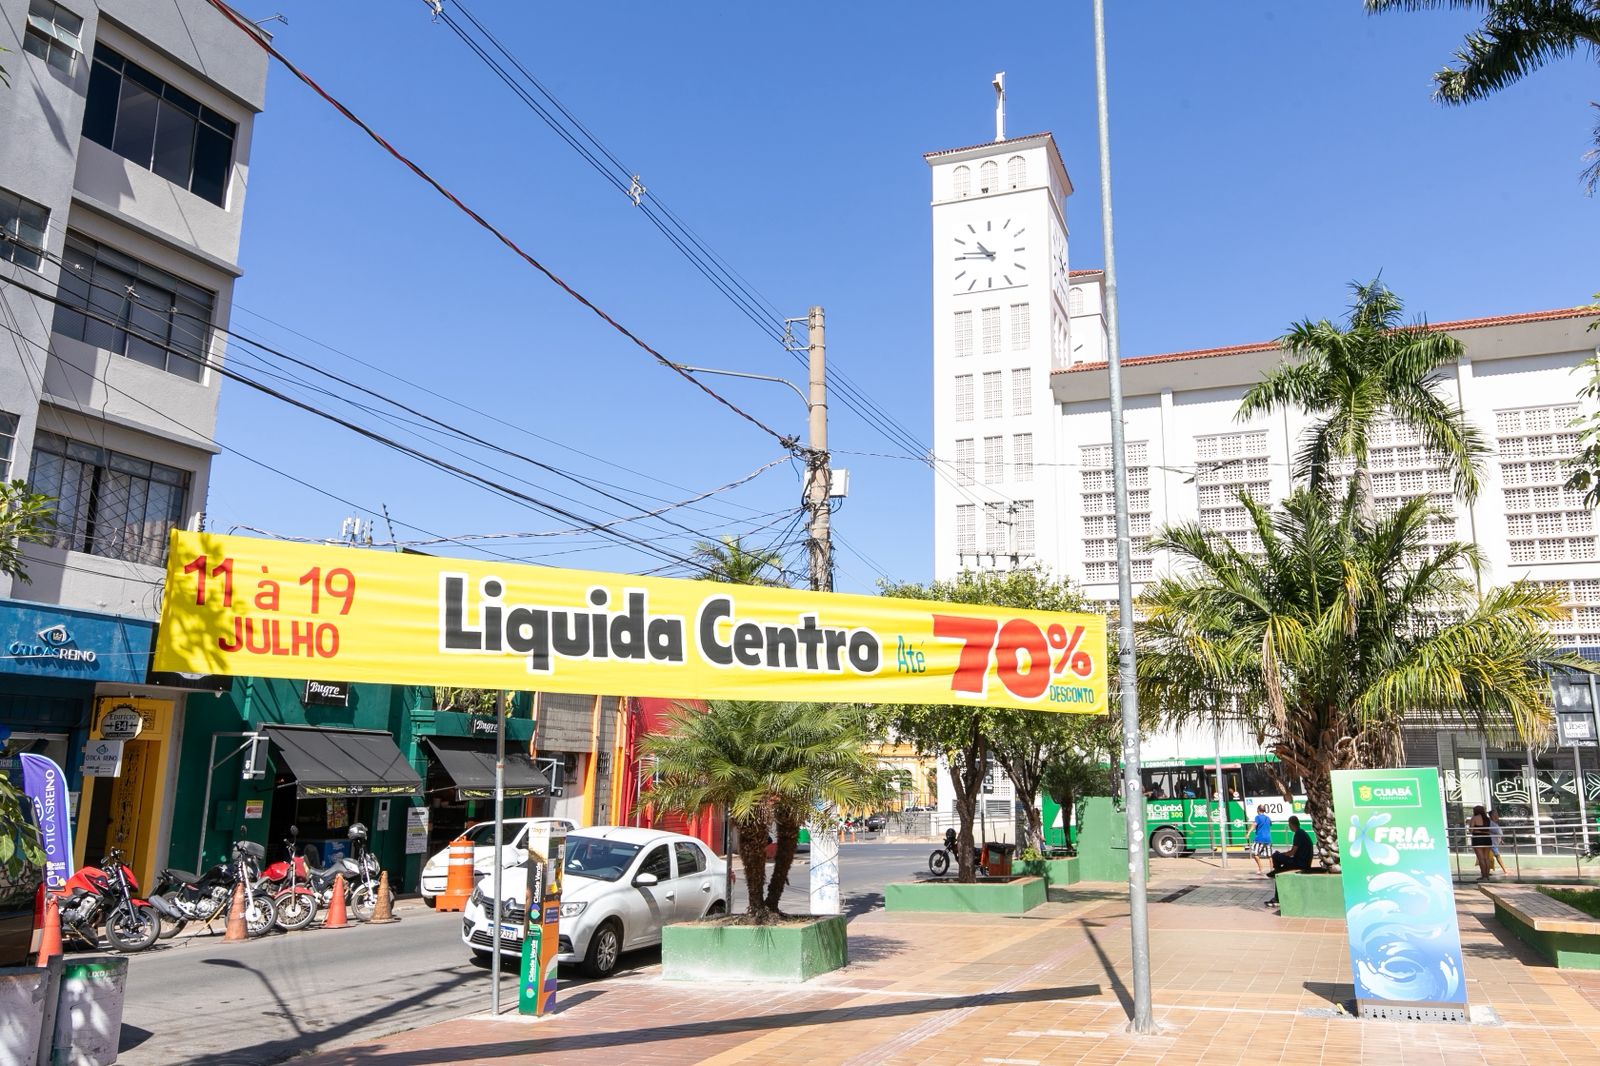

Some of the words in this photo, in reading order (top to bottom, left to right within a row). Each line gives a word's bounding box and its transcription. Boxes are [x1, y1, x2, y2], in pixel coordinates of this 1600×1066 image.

[184, 555, 234, 608] 11
[254, 565, 281, 612] à
[299, 566, 356, 615] 19
[441, 573, 686, 673] Liquida
[698, 596, 882, 675] Centro
[218, 616, 340, 659] JULHO
[897, 634, 926, 674] Até
[932, 613, 1092, 700] 70%
[309, 681, 340, 698] Bugre
[1049, 684, 1095, 704] DESCONTO
[115, 721, 128, 731] 34
[476, 720, 498, 734] Bugre
[1145, 760, 1186, 768] CONDICIONADO
[1373, 786, 1413, 797] CUIABÁ
[45, 769, 56, 855] ÓTICASREINO
[534, 861, 543, 881] Verde
[532, 881, 541, 904] Cidade
[528, 959, 537, 983] Cidade
